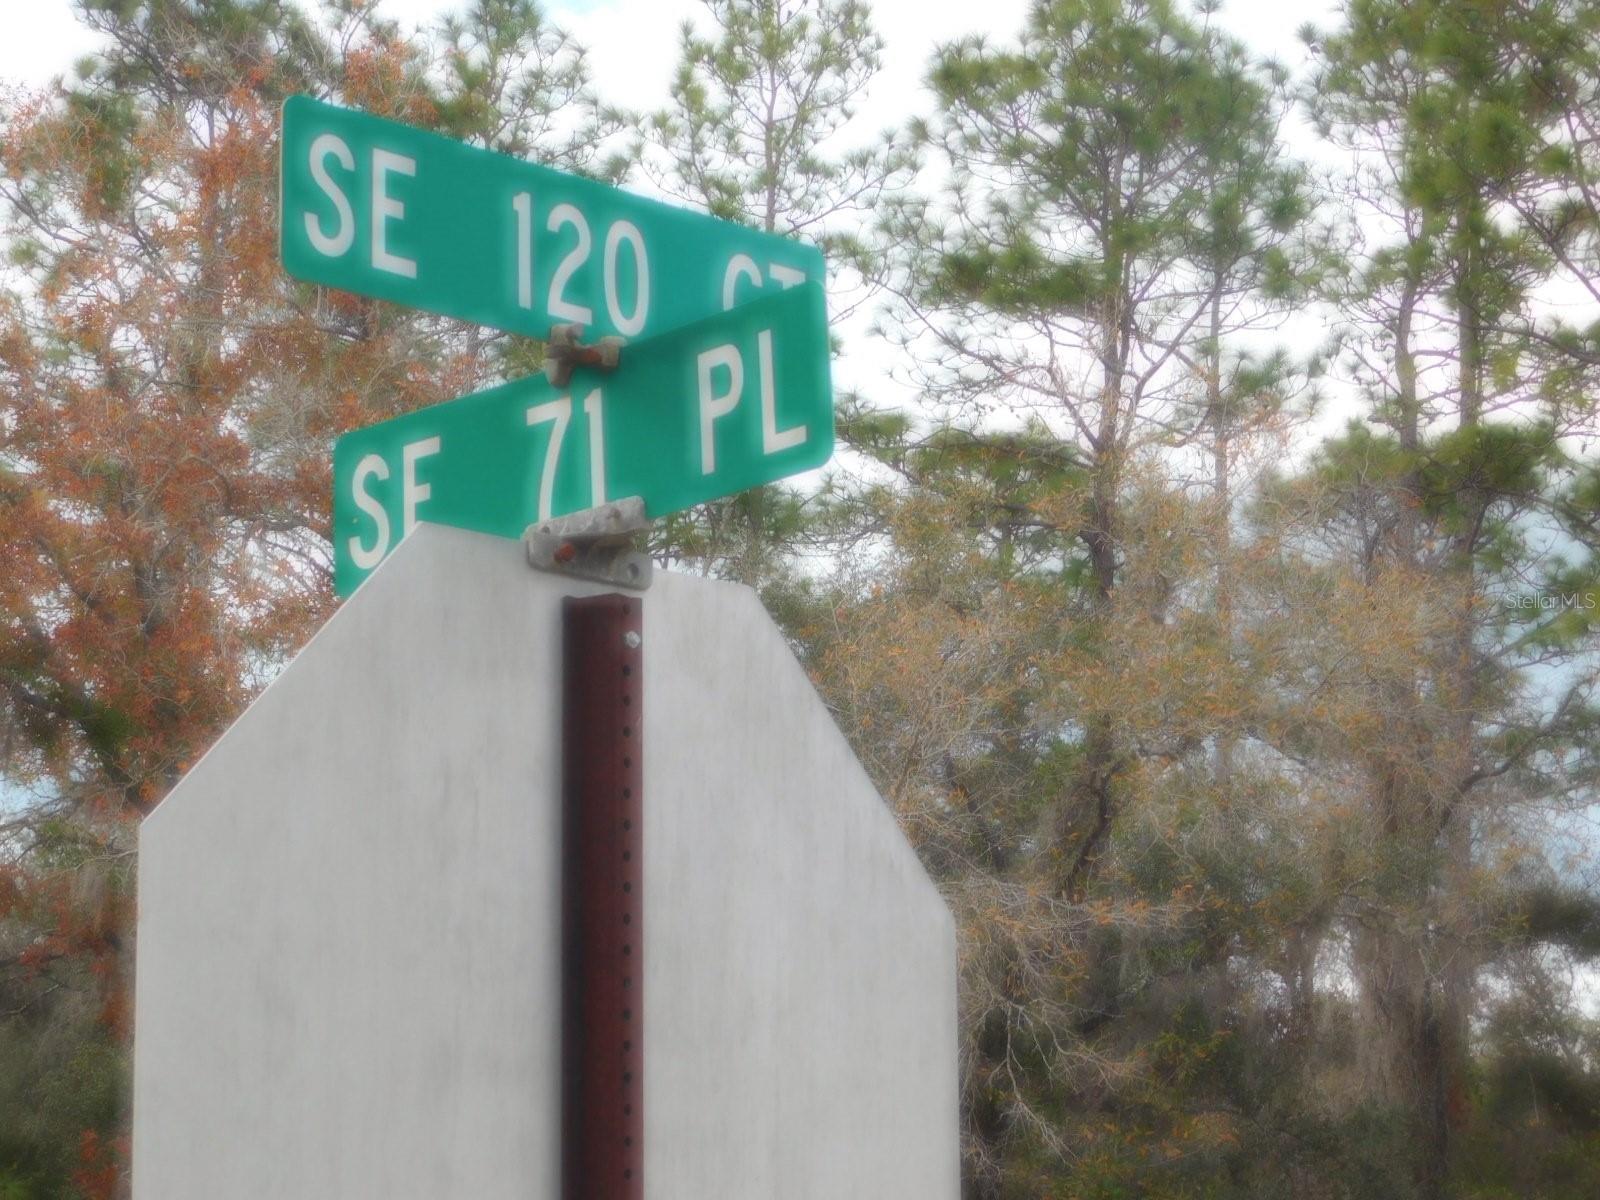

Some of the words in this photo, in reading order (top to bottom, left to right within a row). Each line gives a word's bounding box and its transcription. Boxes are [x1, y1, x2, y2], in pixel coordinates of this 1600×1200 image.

[303, 133, 417, 279] SE
[512, 191, 650, 337] 120
[526, 387, 607, 522] 71
[697, 329, 807, 476] PL
